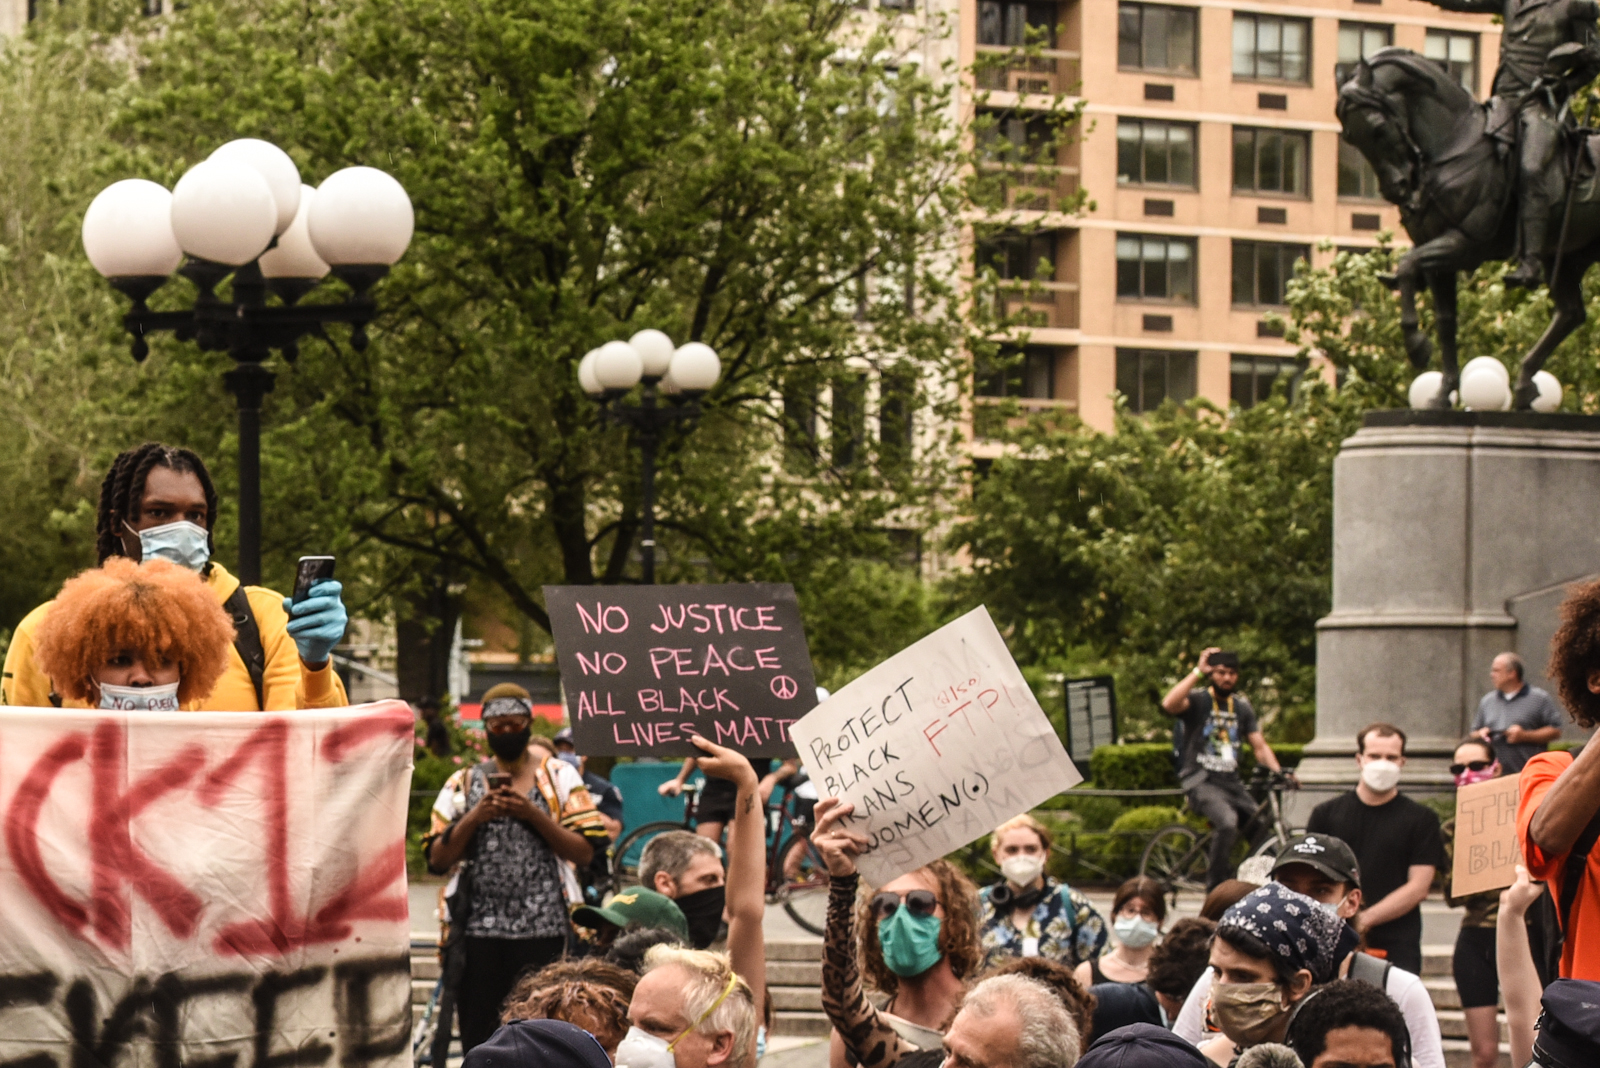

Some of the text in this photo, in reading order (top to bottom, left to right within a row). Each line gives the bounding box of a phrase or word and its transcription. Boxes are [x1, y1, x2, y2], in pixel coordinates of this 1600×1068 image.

[576, 602, 782, 635] NO JUSTICE
[575, 644, 782, 679] NO PEACE
[112, 697, 136, 710] NO
[578, 687, 740, 720] ALL BLACK
[613, 722, 700, 747] LIVES
[809, 677, 914, 770] PROTECT
[825, 741, 900, 797] BLACK
